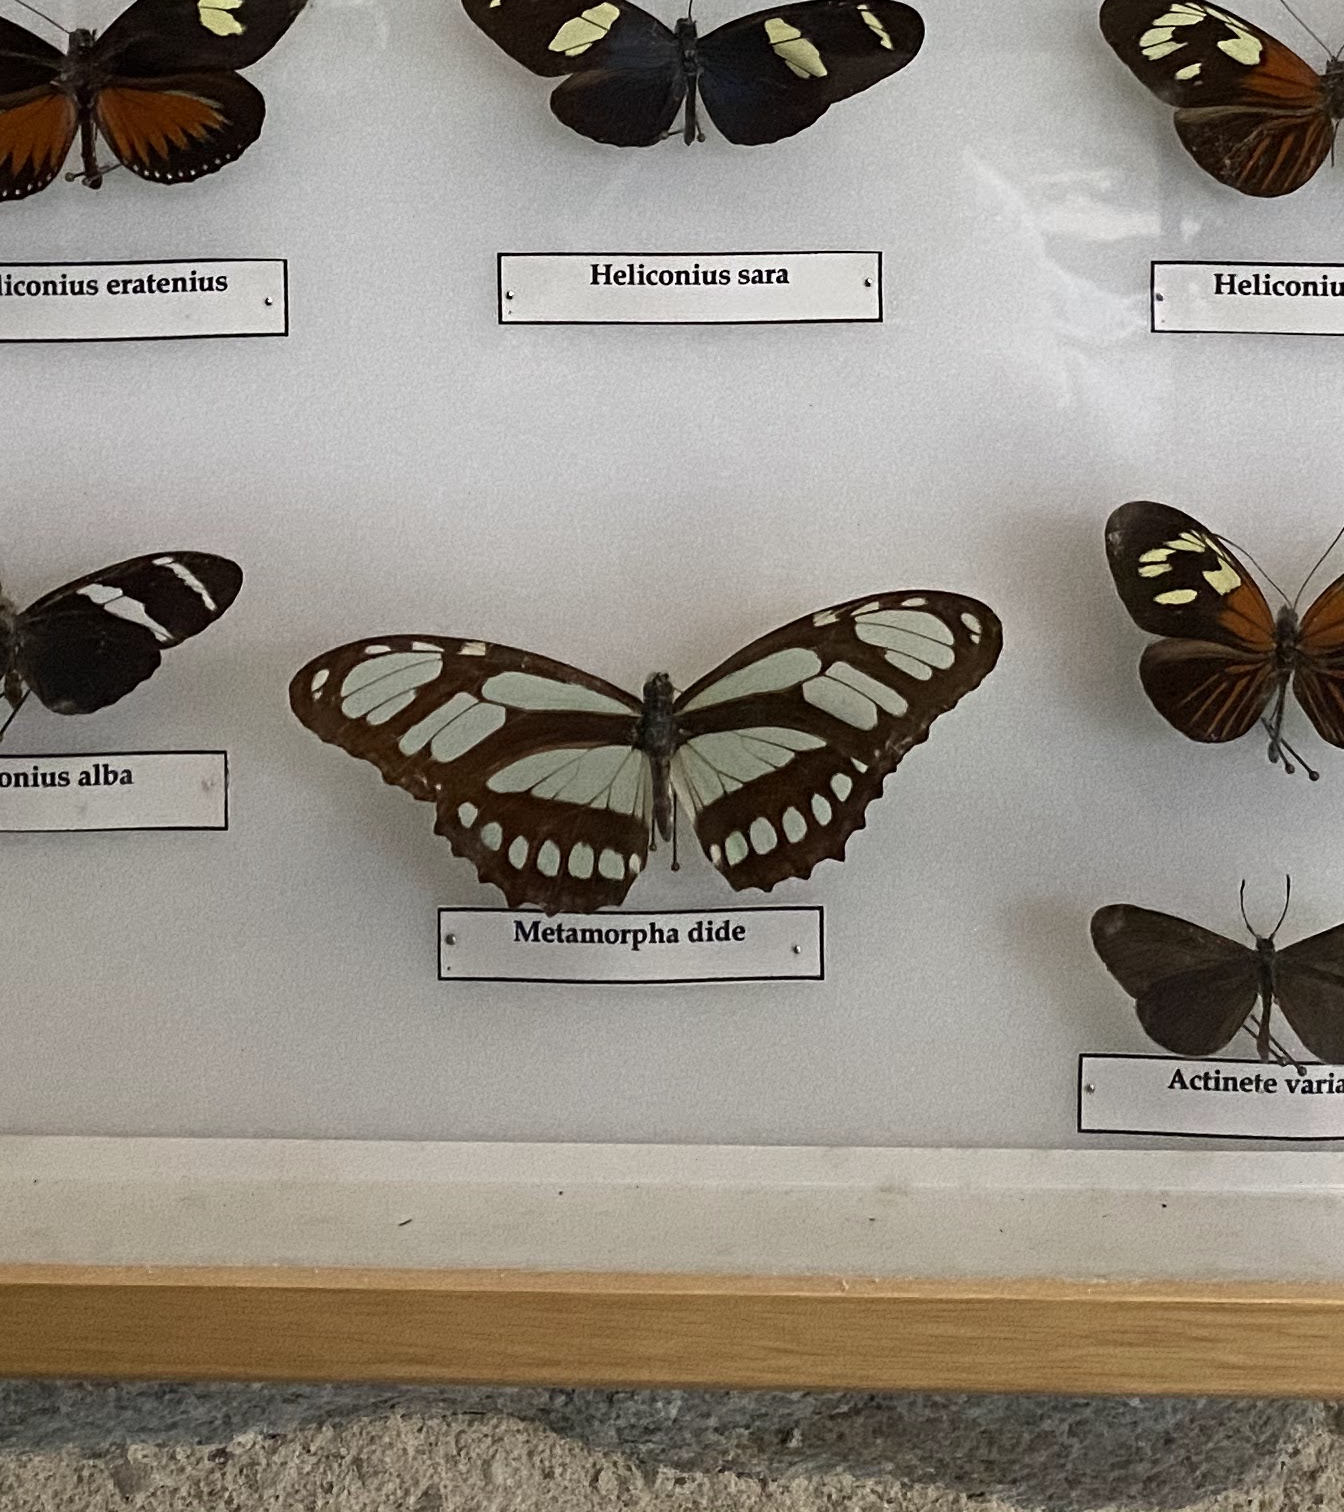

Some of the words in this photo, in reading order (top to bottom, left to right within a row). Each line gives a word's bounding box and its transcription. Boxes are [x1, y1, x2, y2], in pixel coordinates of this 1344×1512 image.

[105, 269, 228, 294] eratenius
[589, 263, 731, 286] Heliconius
[737, 266, 790, 286] sara
[77, 763, 134, 787] alba
[513, 919, 681, 951] Metamorpha
[687, 919, 747, 944] dide
[1167, 1068, 1278, 1094] Actinete
